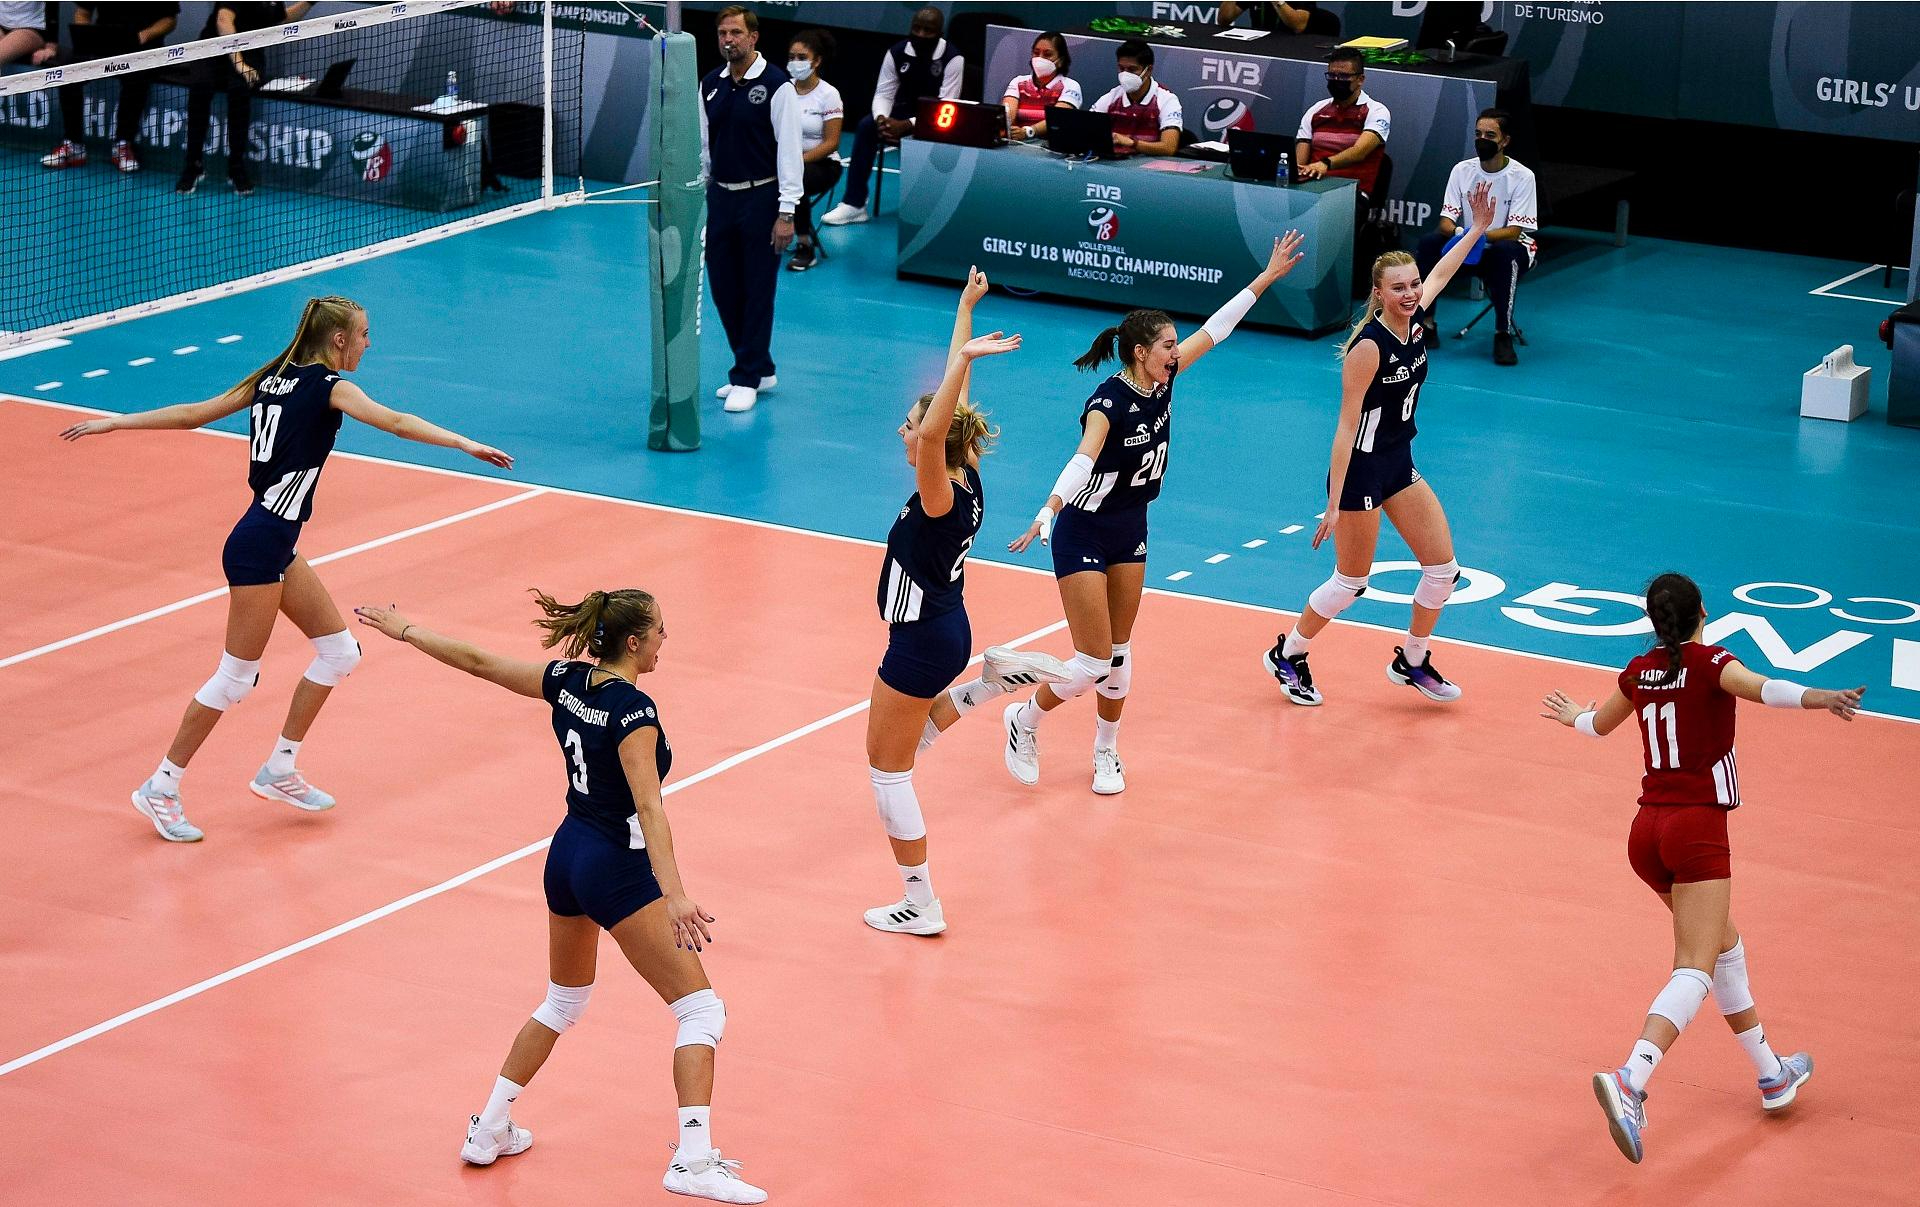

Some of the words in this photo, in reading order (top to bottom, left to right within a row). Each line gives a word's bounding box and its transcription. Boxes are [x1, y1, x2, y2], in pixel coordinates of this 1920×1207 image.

[1152, 2, 1235, 25] FMV
[1515, 4, 1534, 18] DE
[1537, 6, 1604, 25] TURISMO
[104, 62, 131, 74] MIKASA
[1201, 57, 1261, 86] FIVB
[936, 103, 956, 129] 8
[1086, 183, 1122, 200] FIVB
[1096, 223, 1113, 240] 18
[1078, 241, 1126, 255] VOLLEYBALL
[1030, 243, 1058, 262] U18
[1062, 247, 1112, 269] WORLD
[1115, 255, 1223, 284] CHAMPIONSHIP
[1067, 267, 1108, 281] MEXICO
[1109, 272, 1134, 285] 2021
[251, 402, 282, 463] 10
[1126, 434, 1149, 446] ORLEN
[1130, 441, 1168, 487] 20
[620, 709, 645, 727] plus
[1642, 701, 1681, 769] 11
[564, 728, 589, 795] 3
